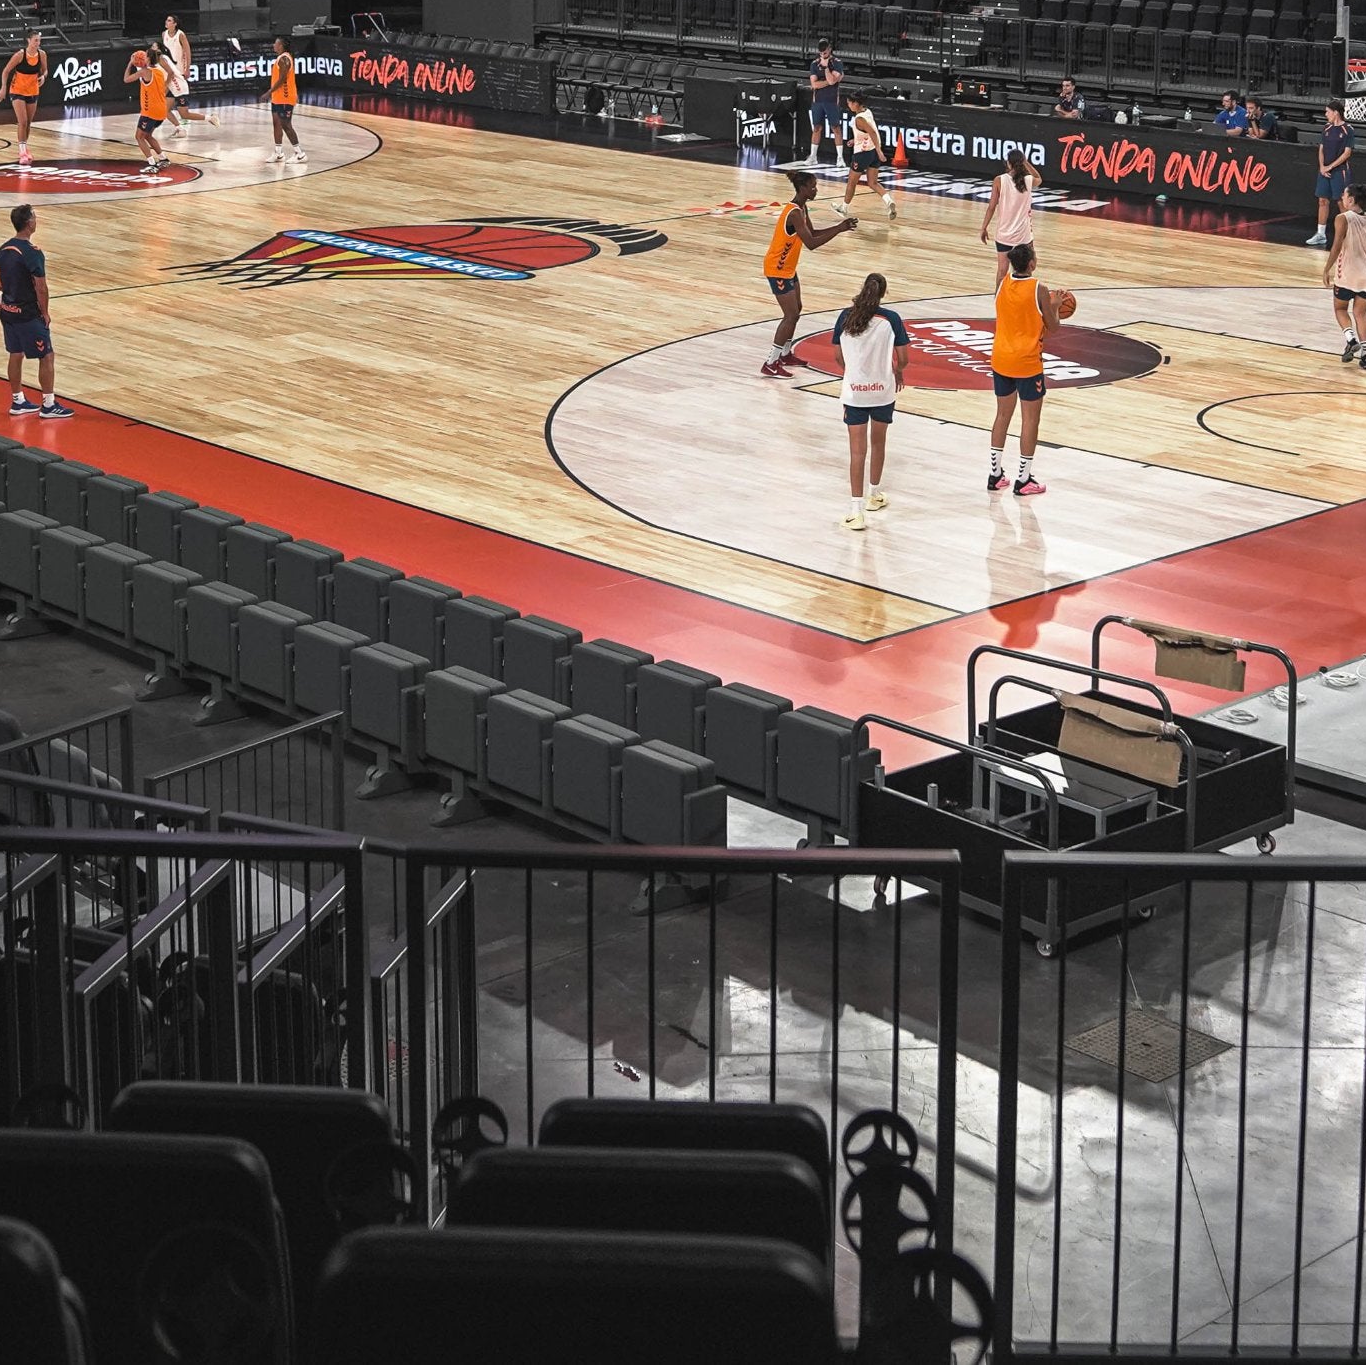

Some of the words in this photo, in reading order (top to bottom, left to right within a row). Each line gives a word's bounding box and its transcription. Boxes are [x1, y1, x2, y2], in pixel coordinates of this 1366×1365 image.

[53, 57, 103, 89] Roig
[205, 55, 275, 82] nuestr
[294, 55, 343, 77] nueva
[64, 80, 103, 102] ARENA
[297, 231, 409, 259] VALENCIA
[411, 253, 519, 278] BASKET
